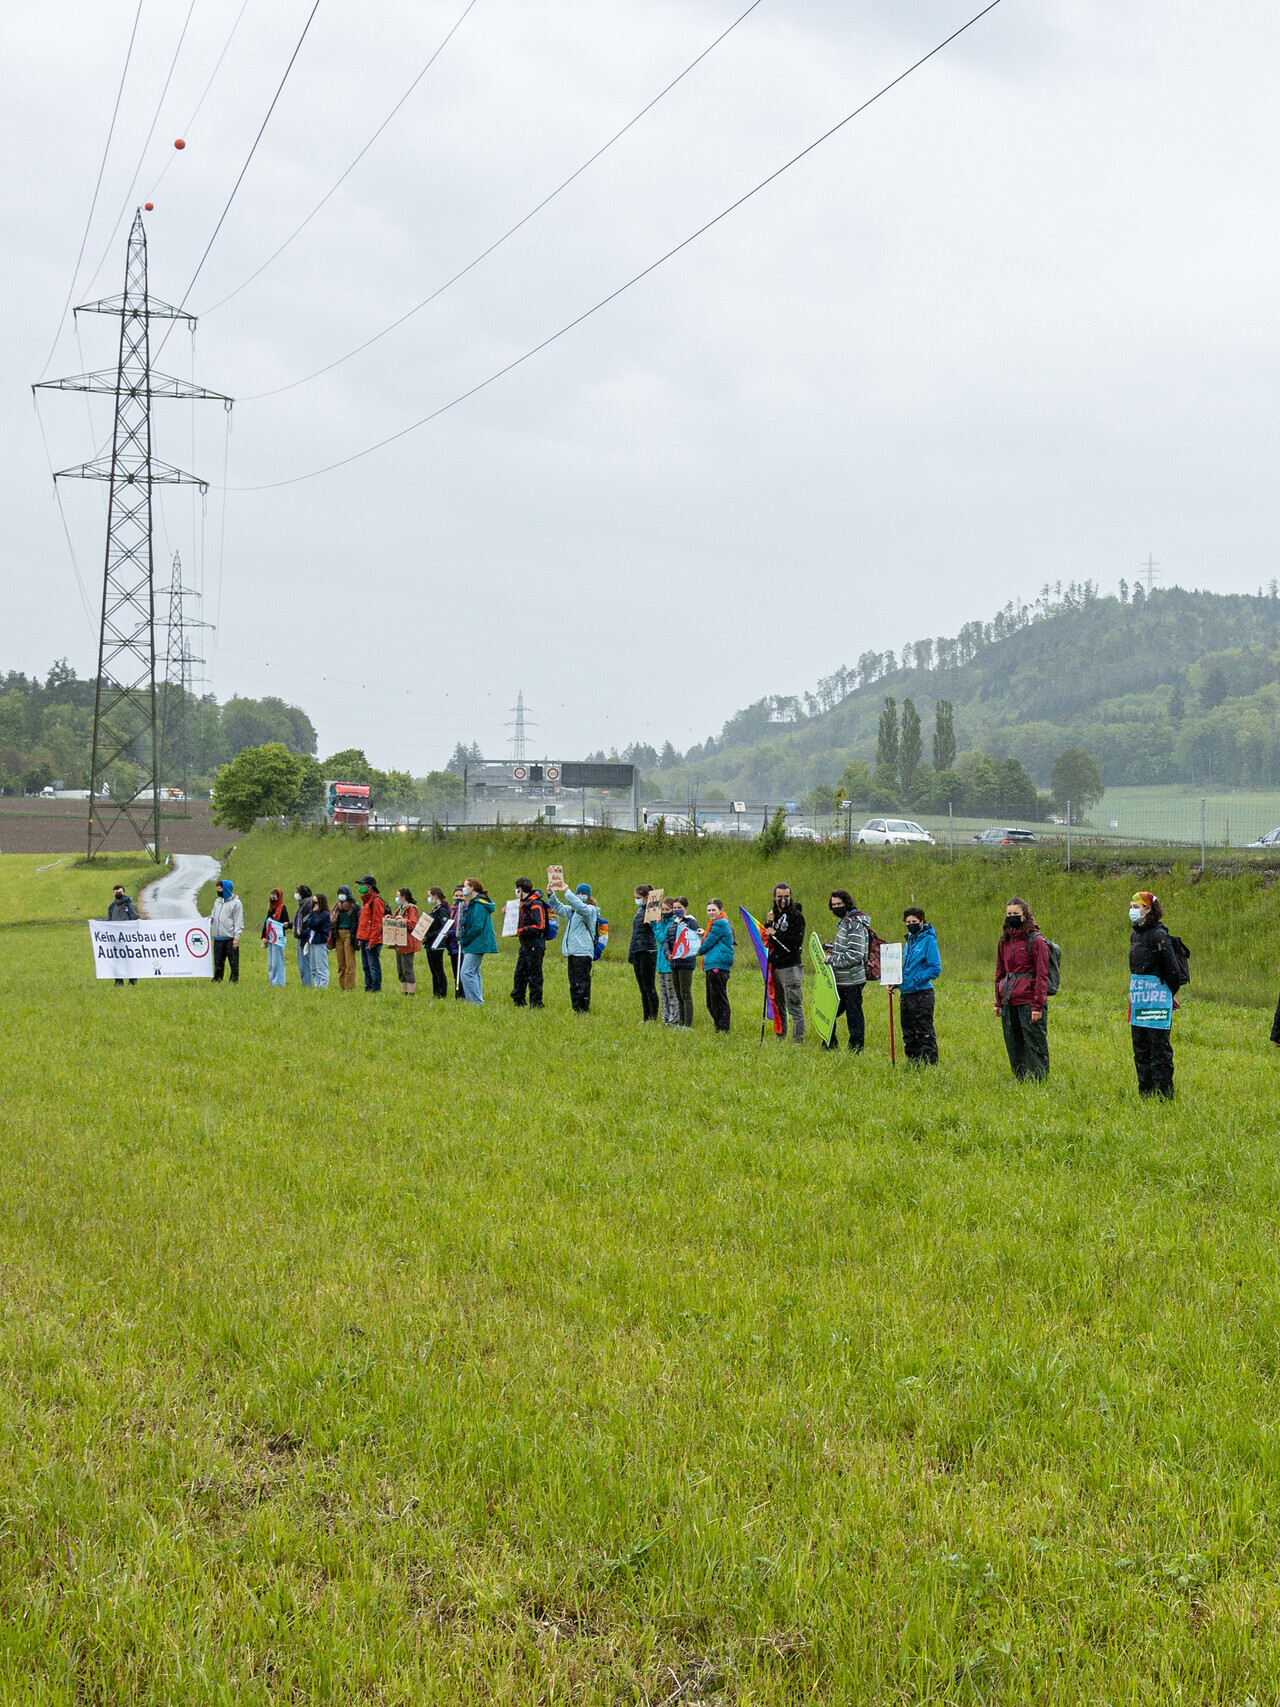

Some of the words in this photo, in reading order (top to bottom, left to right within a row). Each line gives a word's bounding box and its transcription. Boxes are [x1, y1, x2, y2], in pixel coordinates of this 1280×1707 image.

[94, 930, 116, 943] Kein
[118, 930, 157, 943] Ausbau
[159, 930, 177, 941] der
[98, 944, 180, 959] Autobahnen!
[1145, 981, 1158, 989] for
[1130, 990, 1167, 1003] UTURE
